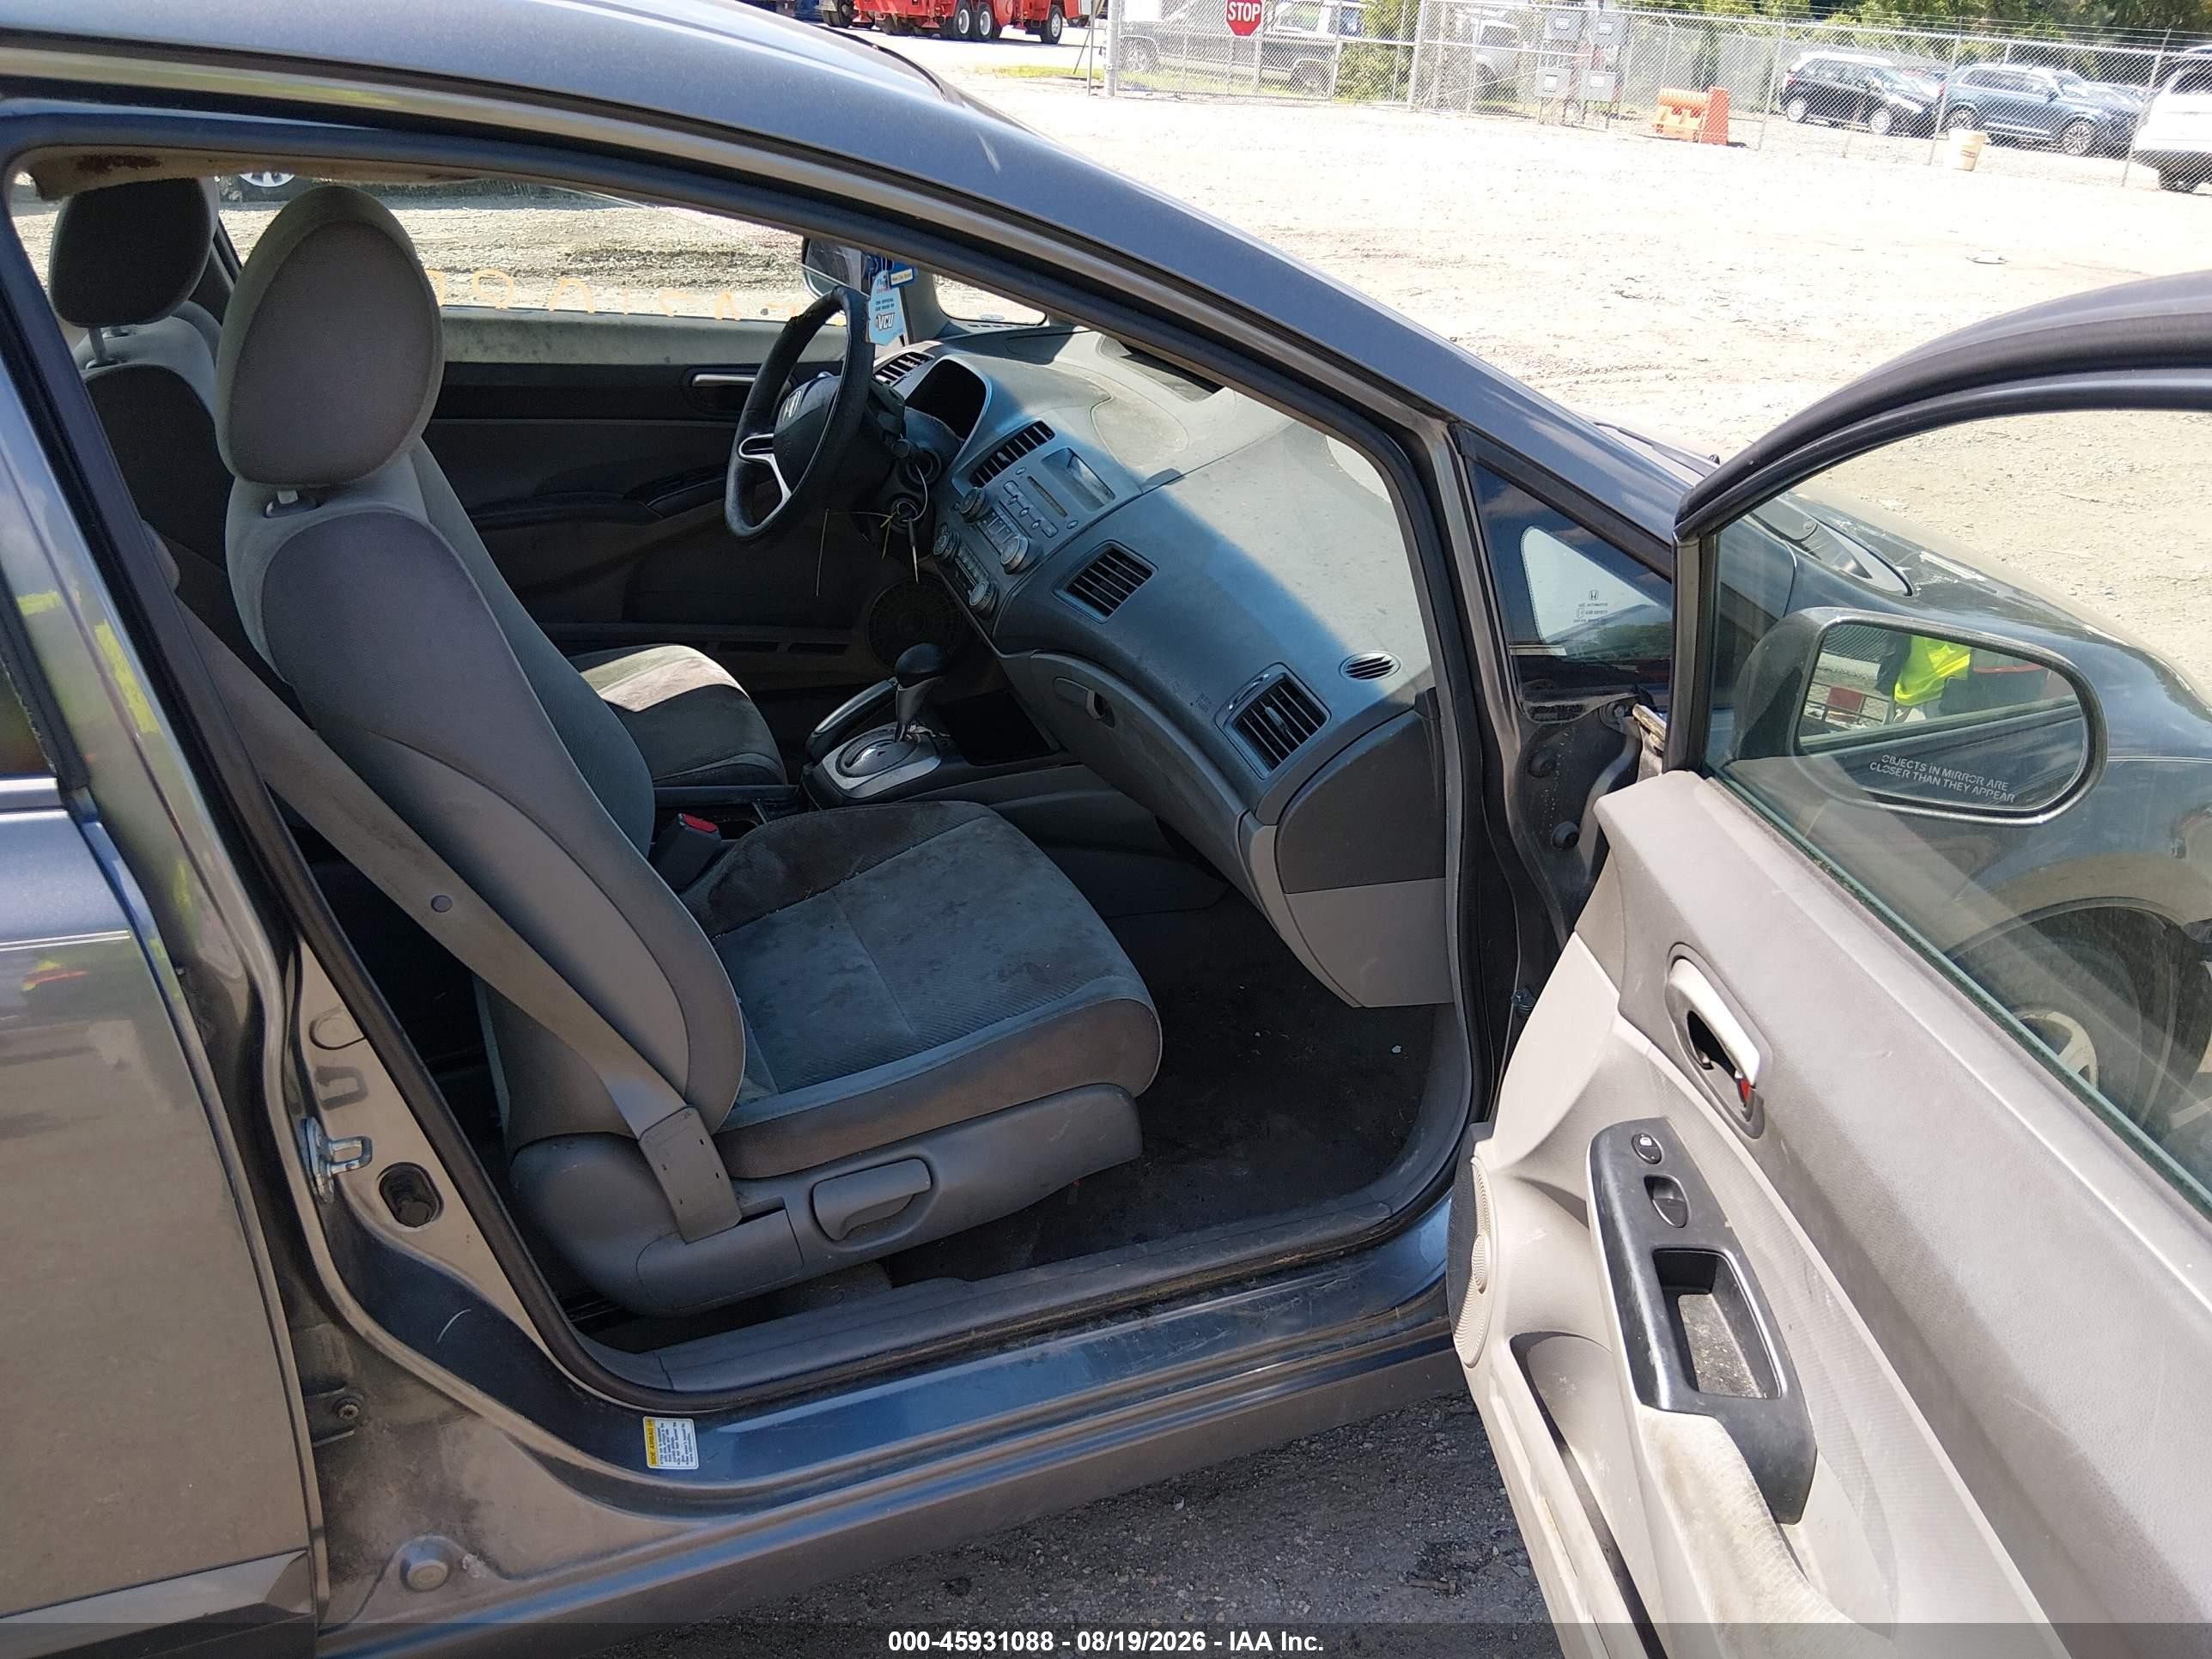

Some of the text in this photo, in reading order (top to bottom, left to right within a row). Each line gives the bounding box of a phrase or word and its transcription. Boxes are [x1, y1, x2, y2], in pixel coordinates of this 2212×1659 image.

[1228, 1, 1261, 22] STOP
[878, 313, 894, 331] VCU
[1869, 762, 2016, 804] CLOSER THAN THEY APPEAR
[1881, 754, 2008, 792] OBJECTS IN MIRROR ARE
